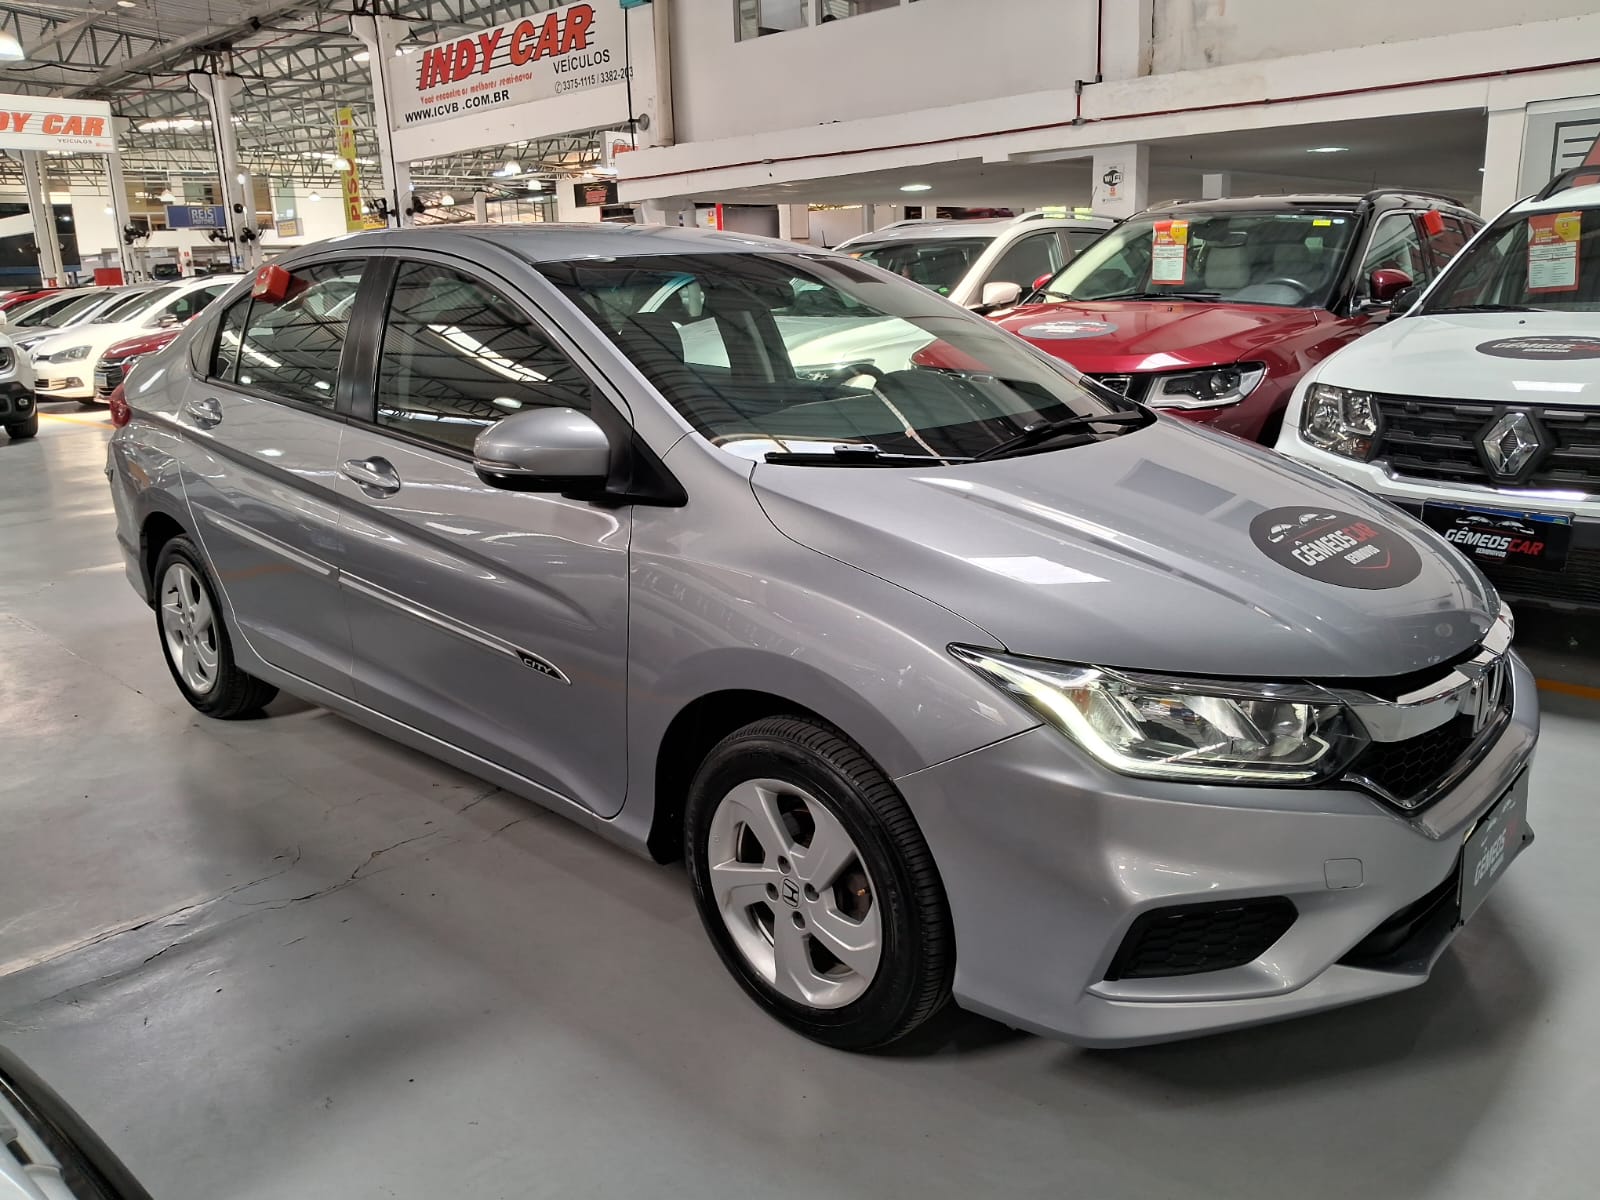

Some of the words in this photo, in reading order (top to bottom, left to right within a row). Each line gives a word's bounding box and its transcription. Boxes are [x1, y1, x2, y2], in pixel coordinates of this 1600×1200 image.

[419, 28, 504, 91] INDY
[510, 4, 593, 66] CAR
[553, 49, 610, 74] VEÍCULOS
[42, 113, 105, 137] CAR
[191, 209, 214, 219] REIS
[523, 658, 552, 674] CITY
